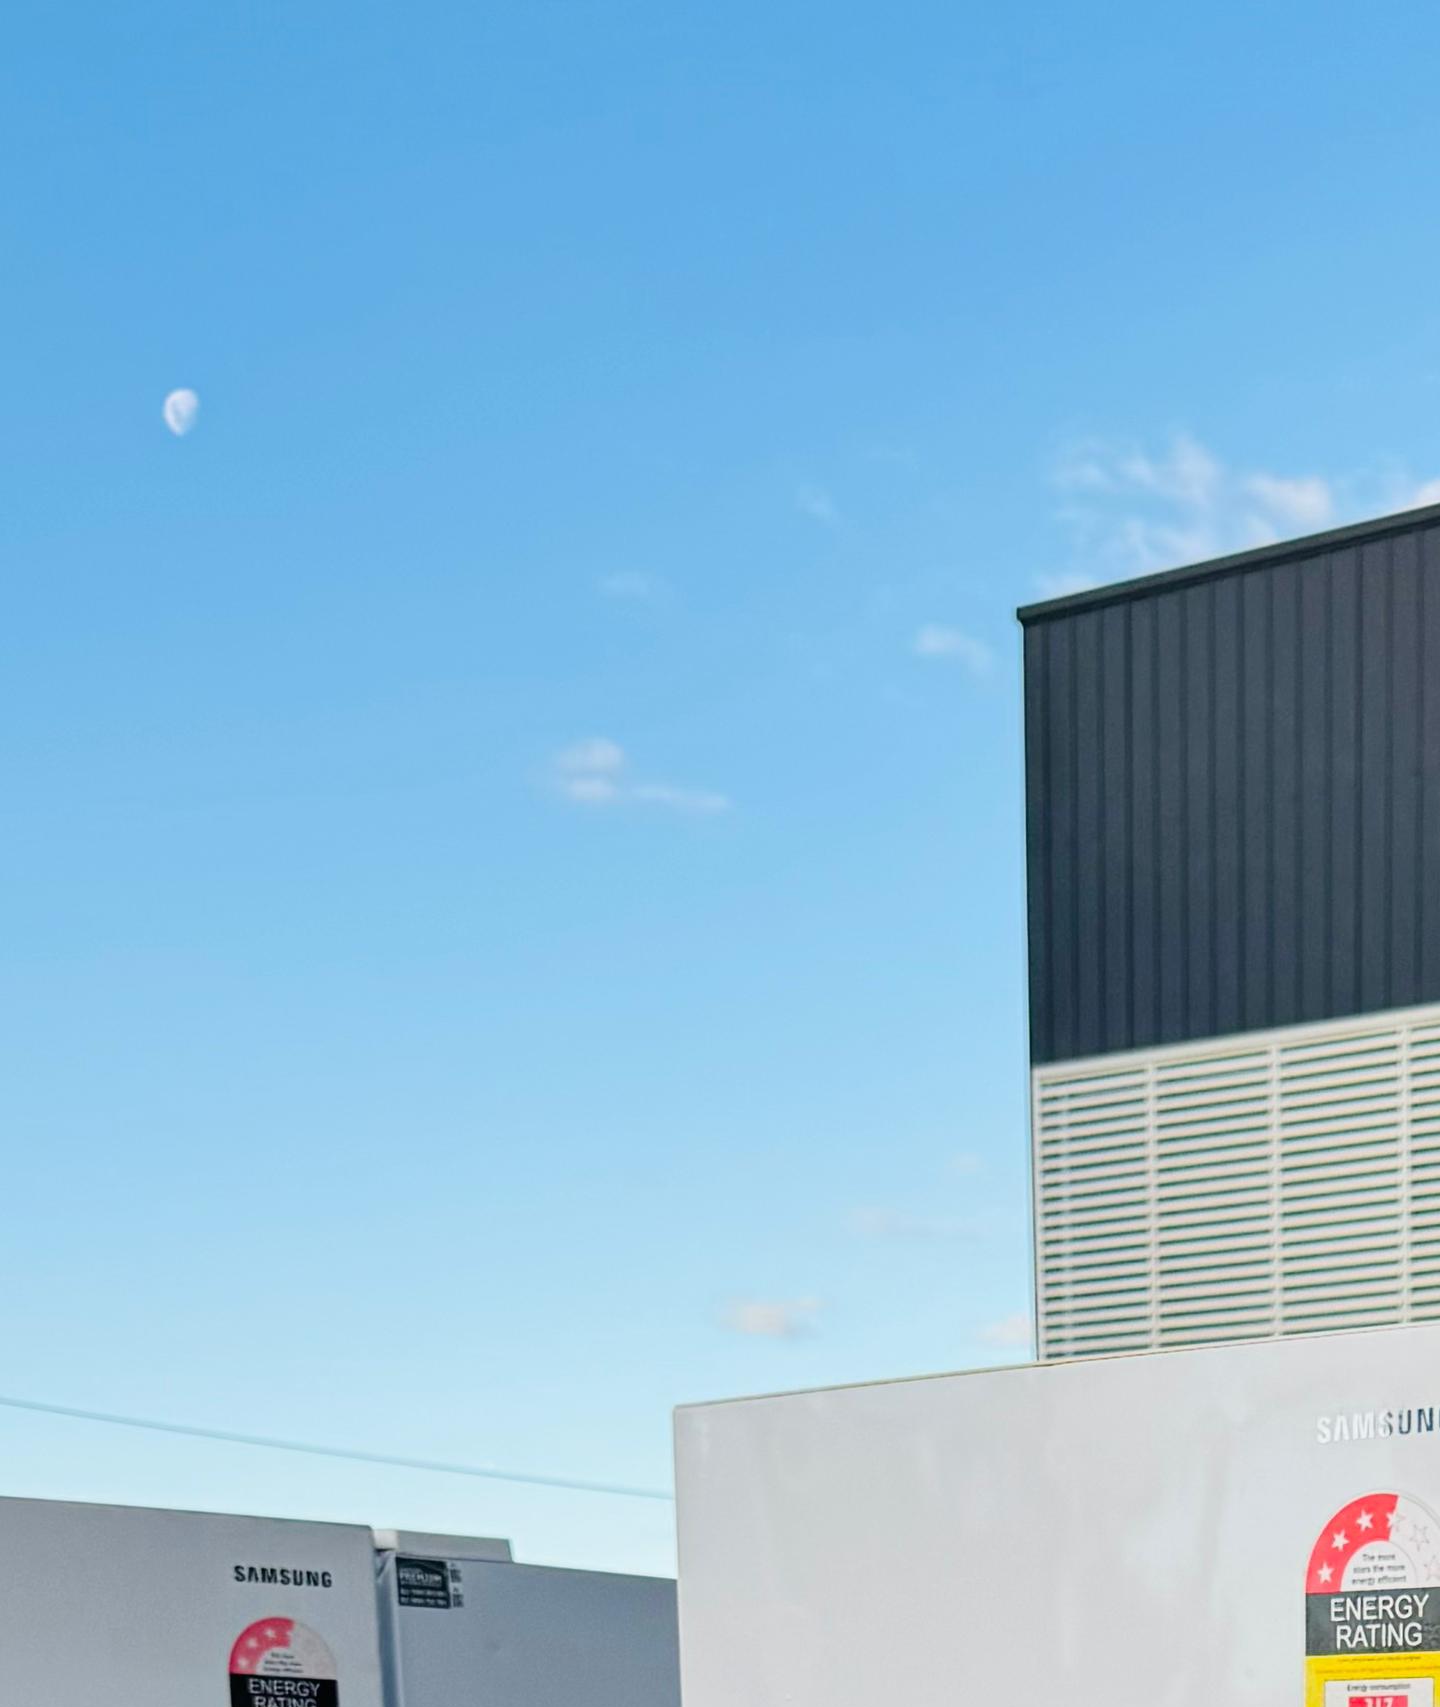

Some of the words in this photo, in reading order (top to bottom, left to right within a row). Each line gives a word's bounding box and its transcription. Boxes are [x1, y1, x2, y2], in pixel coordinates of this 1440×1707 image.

[234, 1565, 332, 1588] SAMSUNG
[1330, 1594, 1430, 1622] ENERGY
[1336, 1622, 1423, 1649] RATING
[248, 1678, 320, 1697] ENERGY
